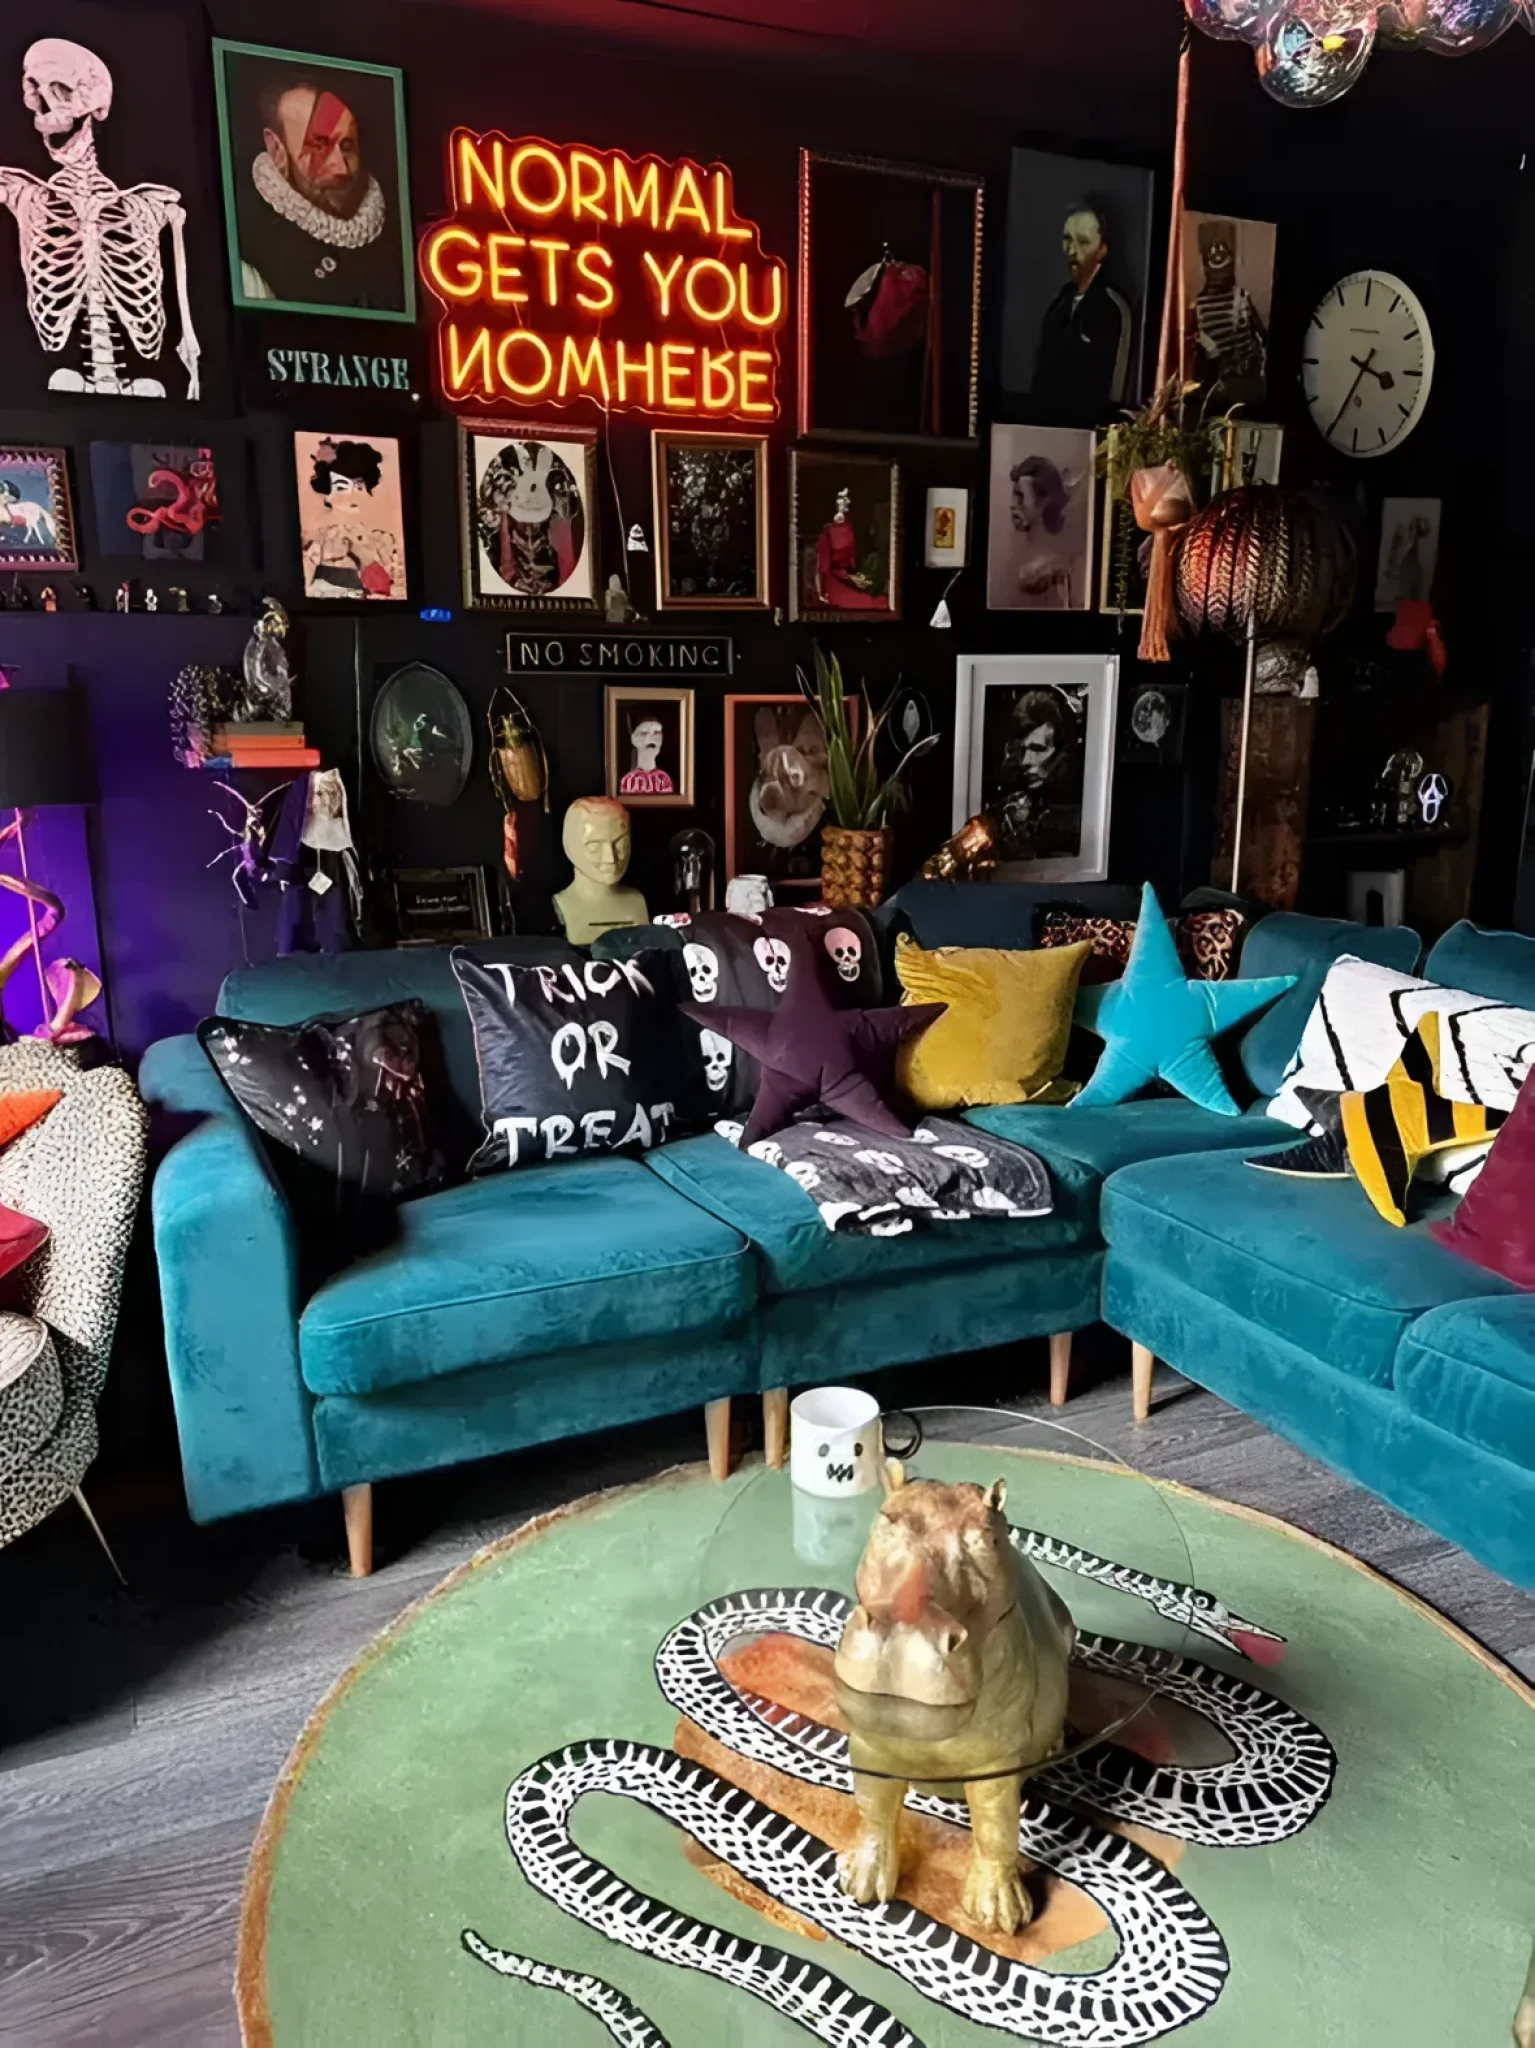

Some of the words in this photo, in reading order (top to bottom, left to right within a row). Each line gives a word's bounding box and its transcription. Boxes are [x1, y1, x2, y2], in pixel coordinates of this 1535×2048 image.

[459, 137, 752, 239] NORMAL
[429, 229, 615, 310] GETS
[643, 250, 782, 326] YOU
[267, 348, 410, 390] STRANGE
[520, 641, 564, 666] NO
[579, 643, 719, 668] SMOKING
[483, 958, 655, 1007] TRICK
[551, 1020, 632, 1090] OR
[493, 1102, 676, 1167] TREAT
